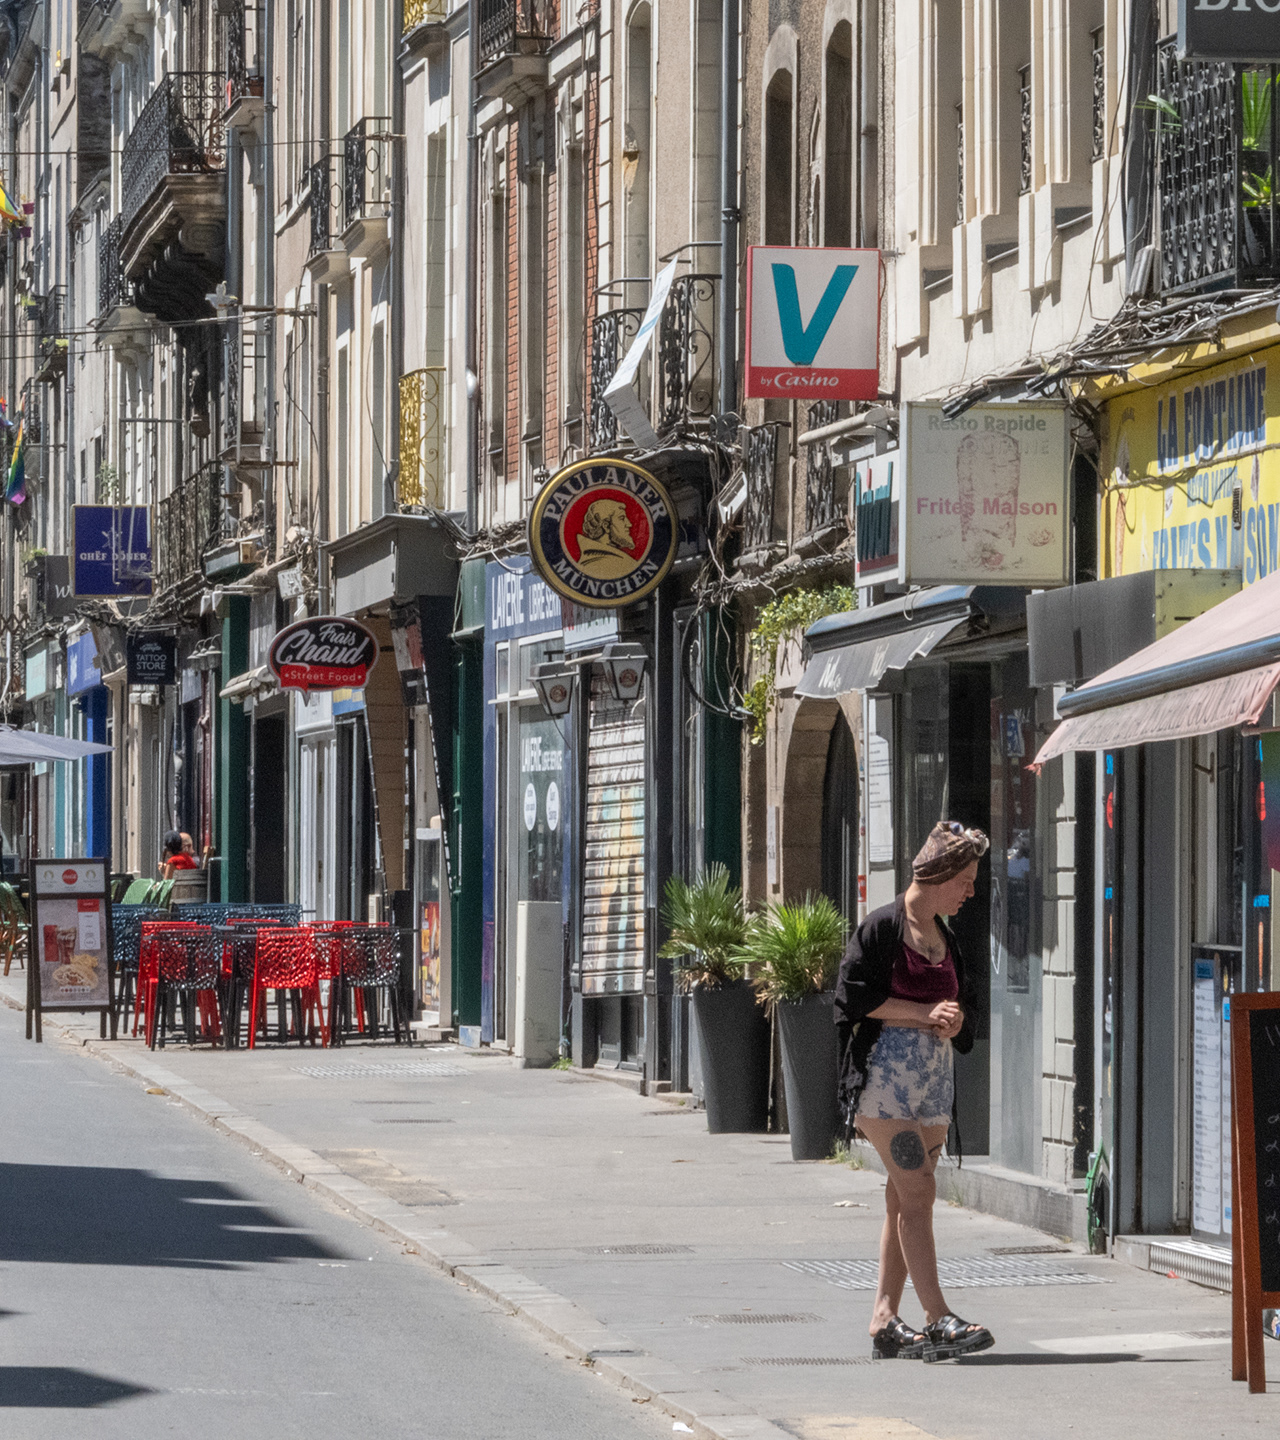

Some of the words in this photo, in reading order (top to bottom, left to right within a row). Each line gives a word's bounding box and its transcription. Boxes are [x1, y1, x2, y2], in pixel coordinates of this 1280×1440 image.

[771, 263, 859, 366] V
[761, 377, 773, 387] by
[774, 372, 839, 390] Casino
[928, 414, 979, 431] Resto
[984, 414, 1046, 434] Rapide
[1158, 390, 1179, 474] LA
[1183, 361, 1267, 464] FONTAINE
[543, 467, 669, 523] PAULANER
[917, 497, 976, 515] Frites
[1153, 517, 1212, 570] FRITES
[552, 559, 660, 598] MÜNCHEN
[492, 568, 524, 630] LAVERIE
[276, 629, 370, 666] Chaud
[319, 622, 357, 646] Frais
[136, 662, 166, 670] STORE
[290, 670, 324, 680] Street
[328, 673, 356, 681] Food
